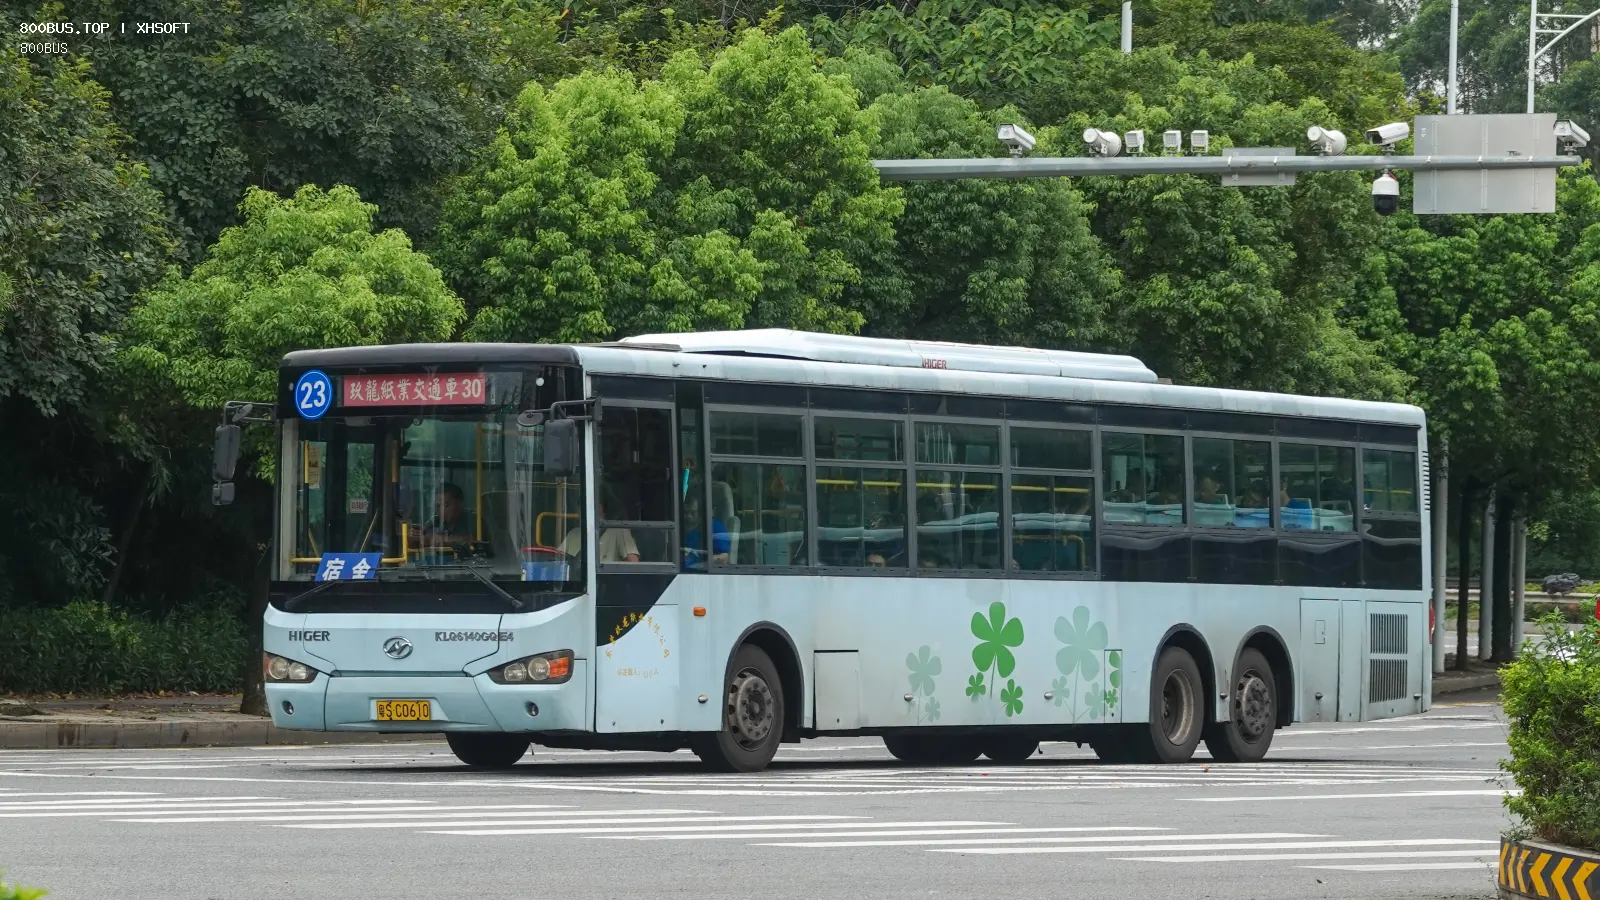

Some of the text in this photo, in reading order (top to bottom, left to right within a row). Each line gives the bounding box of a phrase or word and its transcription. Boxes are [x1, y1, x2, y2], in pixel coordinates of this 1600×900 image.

[923, 358, 948, 370] HIGER
[300, 380, 326, 409] 23
[288, 630, 331, 642] HIGER
